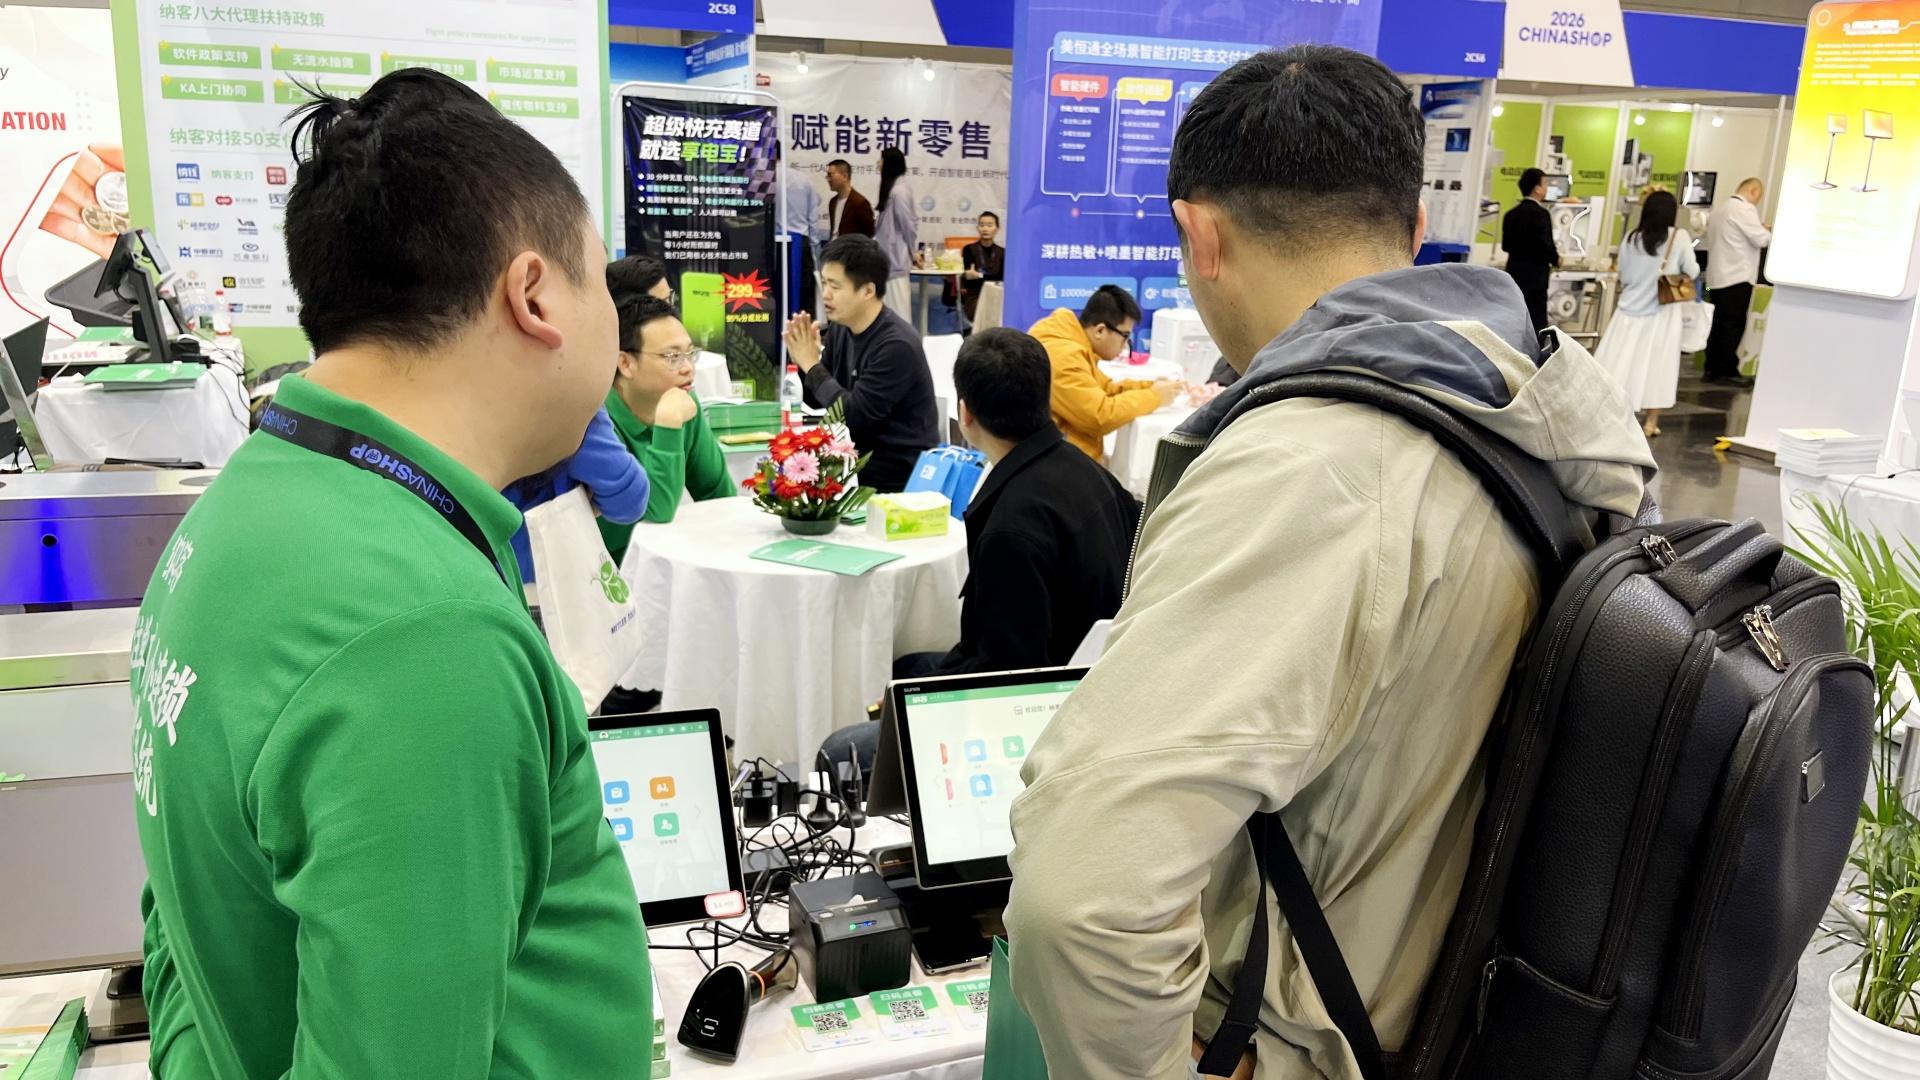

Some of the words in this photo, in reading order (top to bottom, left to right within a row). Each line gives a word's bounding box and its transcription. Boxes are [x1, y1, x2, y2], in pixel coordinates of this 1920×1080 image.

[160, 3, 326, 27] 纳客八大代理扶持政策
[707, 3, 737, 15] 2C58
[1551, 11, 1585, 28] 2026
[1518, 27, 1612, 47] CHINASHOP
[173, 48, 249, 63] 软件政策支持
[499, 66, 566, 81] 市场运营支持
[180, 83, 247, 97] KA上门协同
[643, 115, 762, 141] 超级快充赛道
[791, 113, 992, 160] 赋能新零售
[727, 283, 753, 298] 299
[350, 443, 455, 514] CHINASHOP
